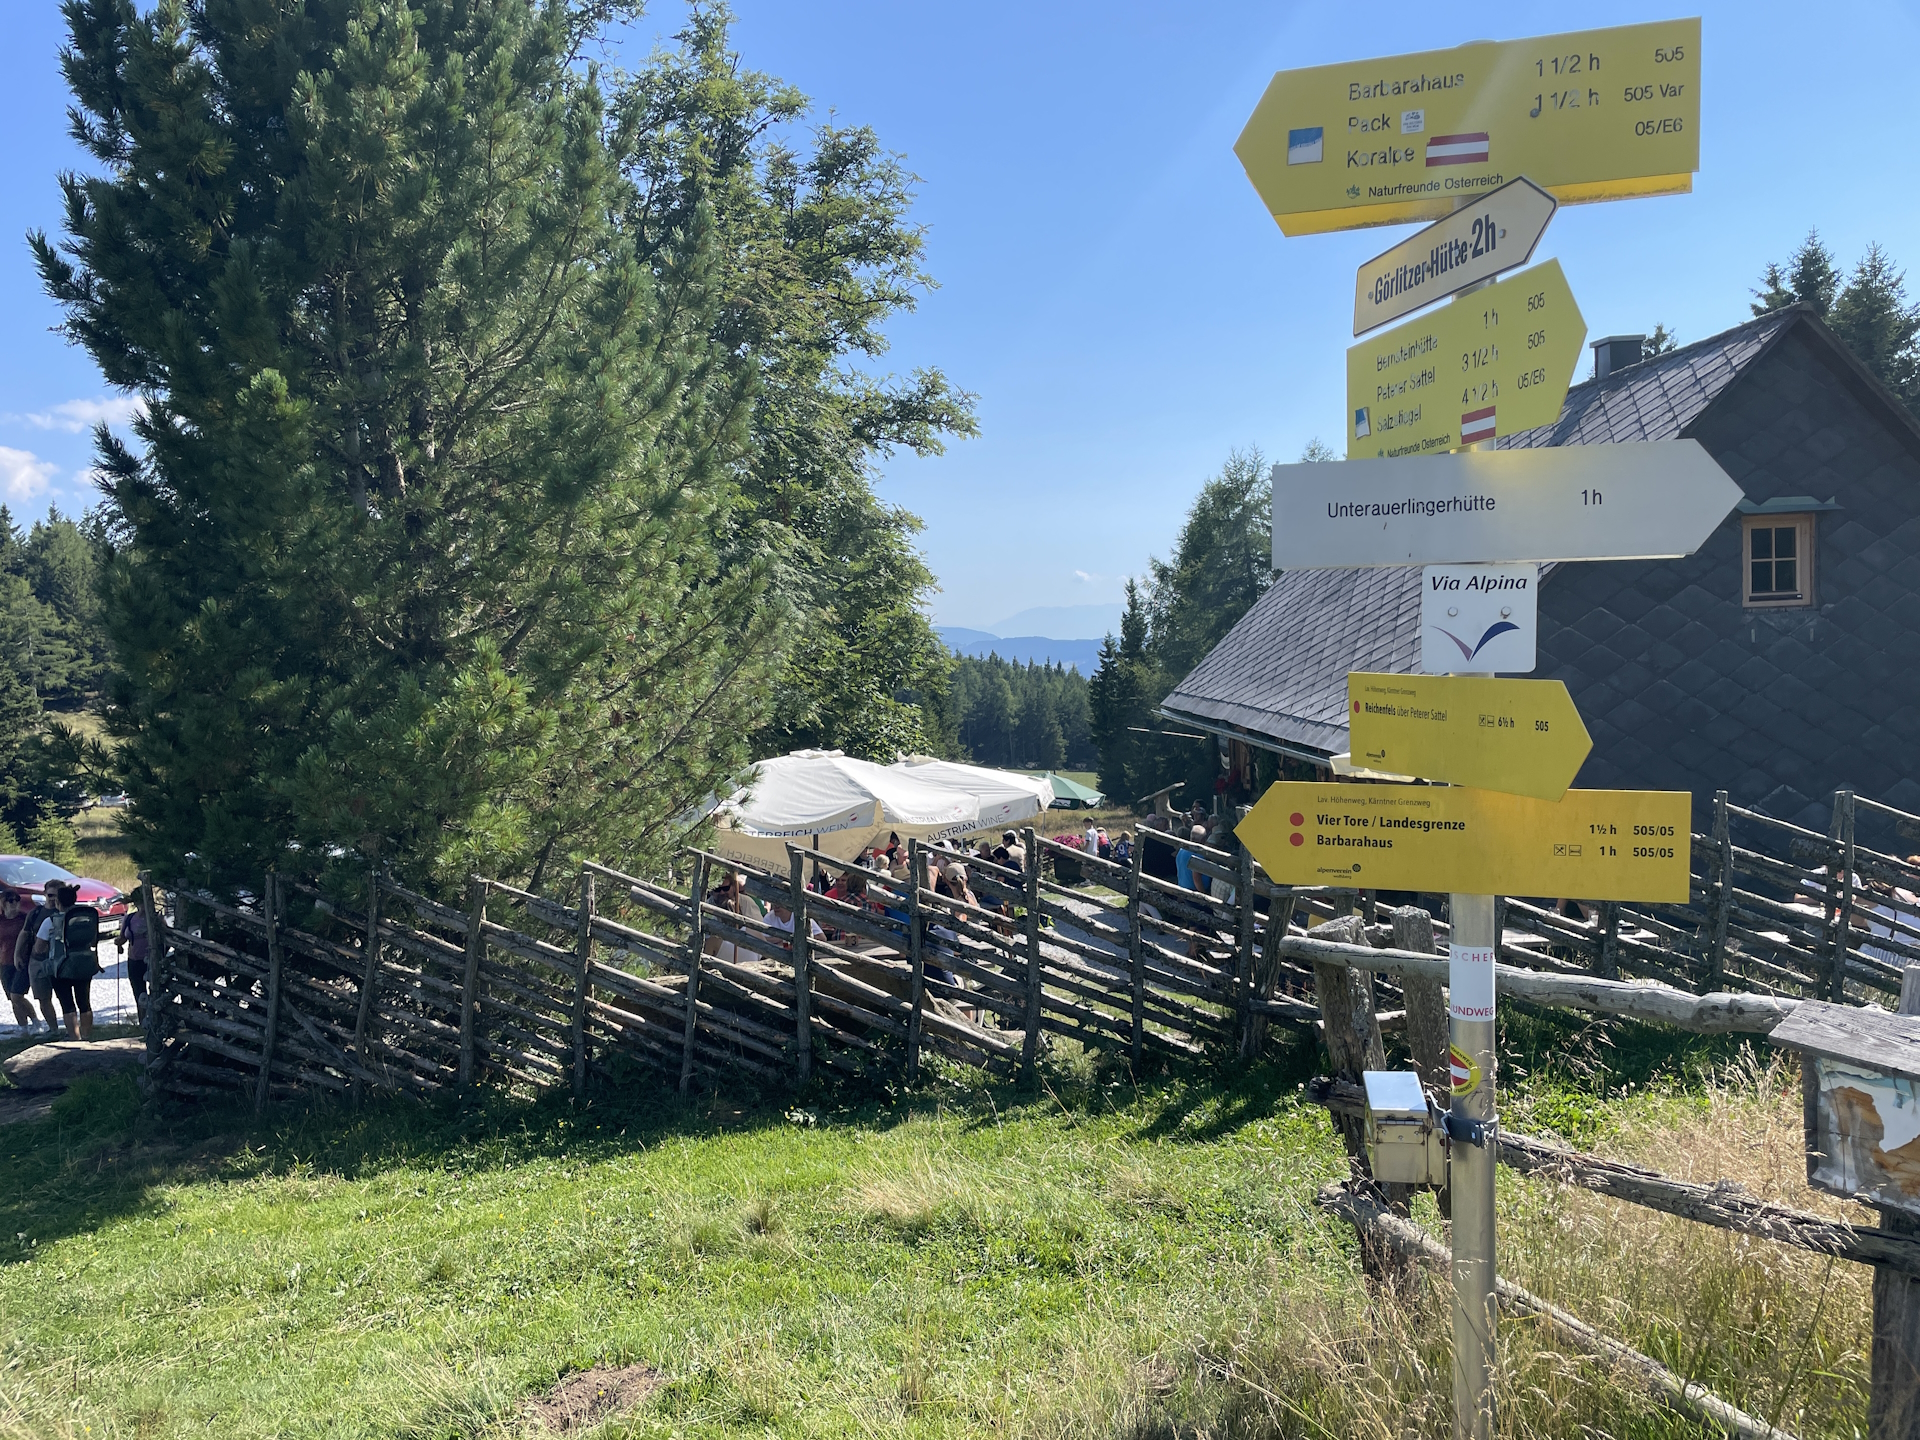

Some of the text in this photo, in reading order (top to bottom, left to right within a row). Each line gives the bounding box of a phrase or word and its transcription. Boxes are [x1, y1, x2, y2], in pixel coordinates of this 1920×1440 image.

[1654, 46, 1684, 63] 505
[1535, 53, 1600, 77] 1 1/2 h
[1349, 73, 1464, 101] Barbarahaus
[1624, 83, 1684, 102] 505 Var
[1550, 89, 1580, 110] 1/2
[1589, 88, 1599, 106] h
[1348, 113, 1391, 134] Pack
[1635, 117, 1683, 136] 05/E6
[1347, 146, 1414, 168] Koralpe
[1368, 173, 1503, 198] Naturfreunde Österreich
[1528, 292, 1545, 312] 505
[1528, 330, 1545, 349] 505
[1377, 334, 1438, 372] Bernsteinhütte
[1462, 353, 1469, 372] 3
[1472, 347, 1488, 368] 1/2
[1377, 366, 1435, 402] Peterer Sattel
[1517, 368, 1545, 390] 05/E6
[1462, 388, 1469, 405] 4
[1377, 403, 1421, 432] Salzstiegel
[1388, 442, 1420, 457] Naturfreunde
[1328, 494, 1495, 518] Unterauerlingerhütte
[1432, 575, 1527, 593] Via Alpina
[1365, 702, 1448, 722] Reichenfels über Peterer Sattel
[1535, 720, 1549, 732] 505
[1330, 796, 1367, 807] Höhenweg,
[1369, 797, 1397, 805] Kärntner
[1398, 798, 1431, 808] Grenzweg
[817, 822, 849, 834] WEIN
[927, 814, 1005, 843] AUSTRIAN WINE
[1317, 814, 1341, 826] Vier
[1344, 815, 1369, 827] Tore
[1380, 816, 1466, 833] Landesgrenze
[1610, 824, 1617, 835] h
[1633, 825, 1674, 837] 505/05
[1118, 844, 1125, 855] 9
[1317, 834, 1393, 849] Barbarahaus
[1599, 846, 1617, 856] 1 h
[1633, 847, 1674, 858] 505/05
[1317, 866, 1352, 874] alpenverein
[1451, 1003, 1494, 1017] UNDWEG
